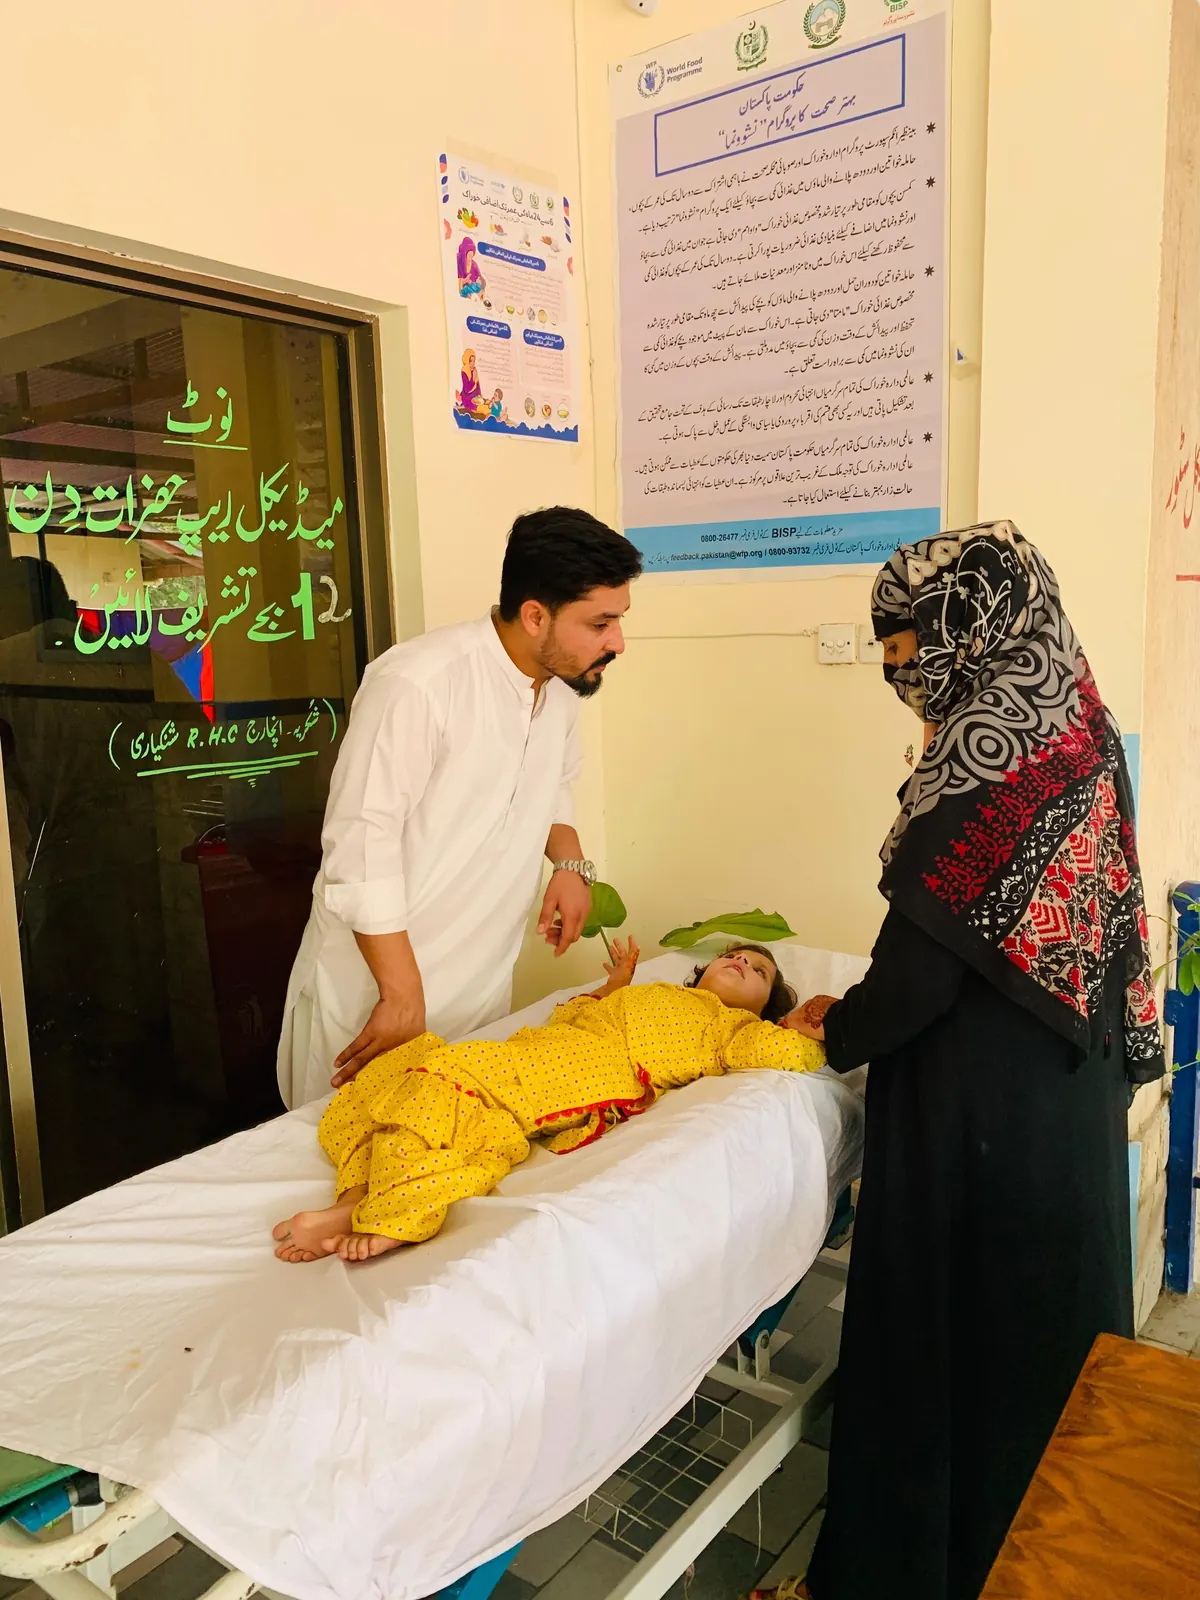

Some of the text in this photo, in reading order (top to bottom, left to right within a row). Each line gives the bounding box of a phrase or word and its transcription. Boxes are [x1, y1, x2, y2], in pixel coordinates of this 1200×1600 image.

[890, 0, 909, 13] BISP
[645, 60, 657, 70] WFP
[666, 56, 703, 75] World Food
[666, 66, 703, 83] Programme
[739, 71, 806, 116] حکومت پاکستان
[837, 94, 856, 116] بہتر
[799, 103, 809, 123] کا
[811, 95, 836, 119] صحت
[766, 104, 796, 139] پروگرام
[167, 380, 233, 442] نوٹ
[86, 473, 188, 545] حضرات
[236, 463, 344, 550] میڈیکل
[176, 490, 233, 555] ریپ
[771, 527, 797, 538] BISP
[701, 533, 739, 542] 0800-26477
[670, 549, 763, 561] feedback.pakistan@wfp.org
[768, 547, 811, 556] 0800-93732
[158, 566, 258, 653] تشریف
[247, 602, 296, 642] بجے
[246, 715, 282, 748] انچارج
